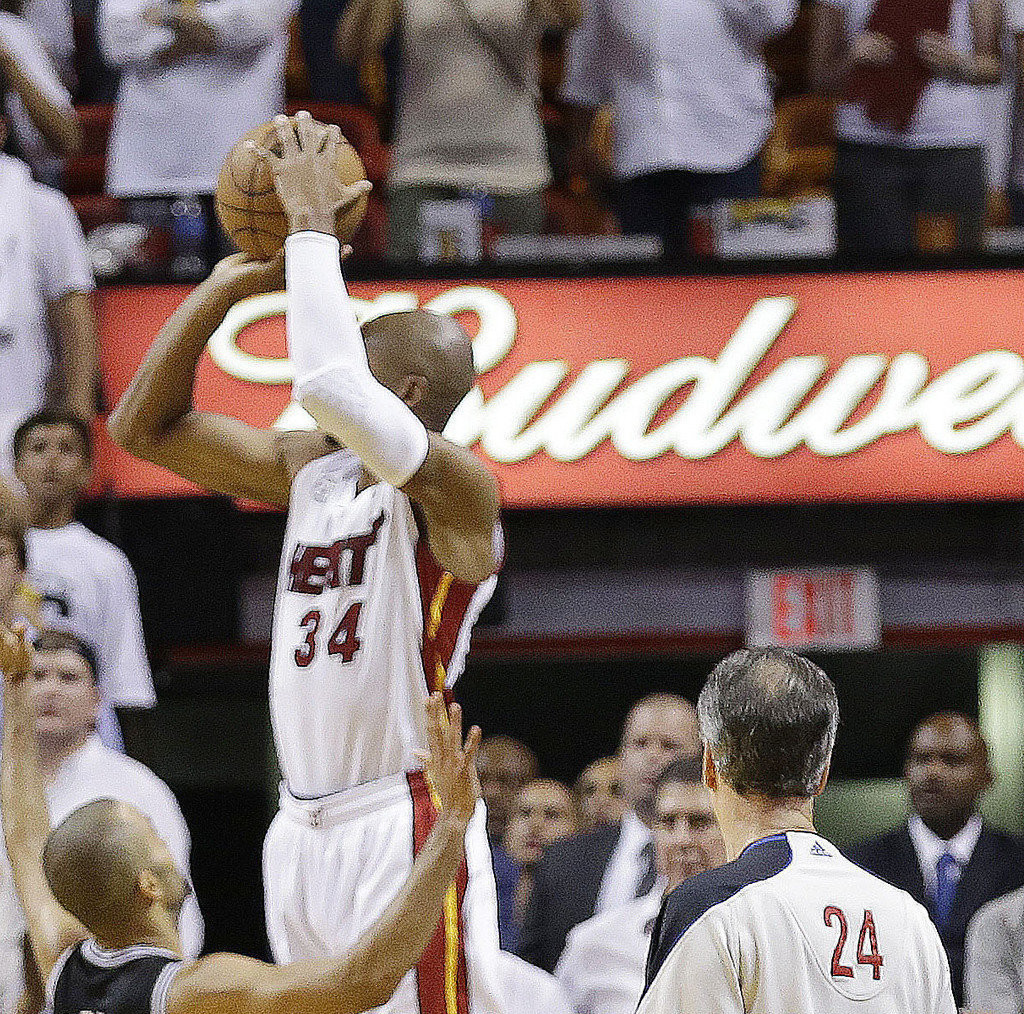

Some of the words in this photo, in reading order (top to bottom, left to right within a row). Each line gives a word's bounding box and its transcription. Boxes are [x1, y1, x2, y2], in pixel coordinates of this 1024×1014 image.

[207, 285, 1024, 464] Budwe
[294, 602, 363, 668] 34
[823, 905, 884, 981] 24
